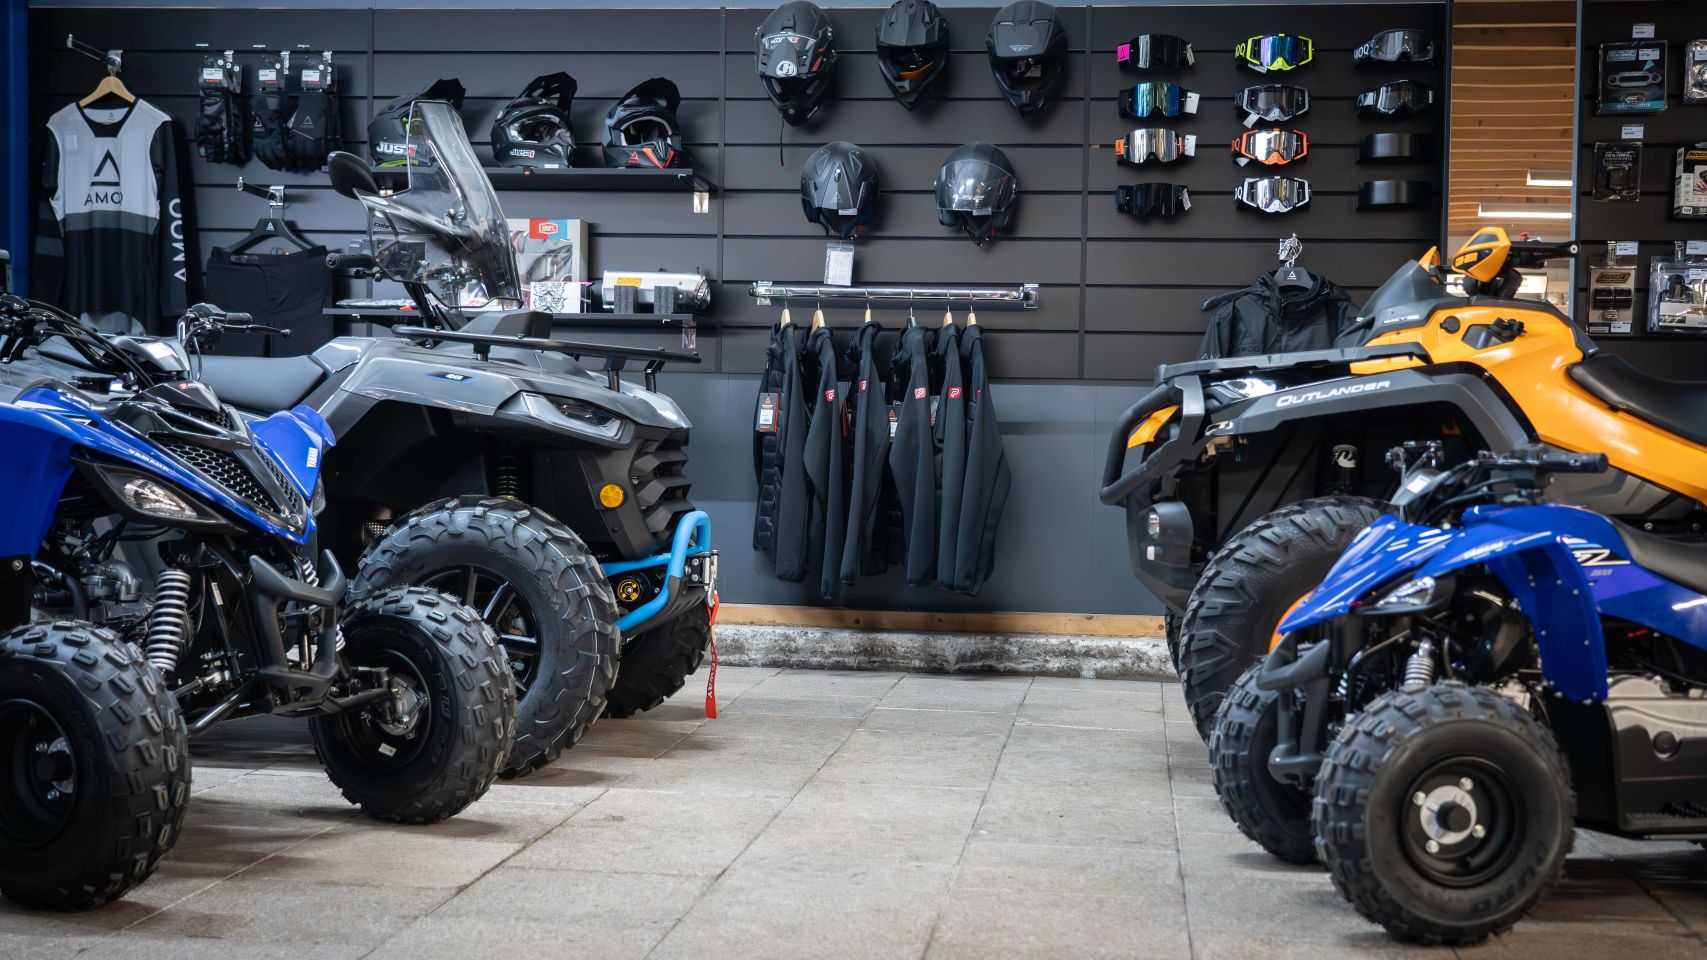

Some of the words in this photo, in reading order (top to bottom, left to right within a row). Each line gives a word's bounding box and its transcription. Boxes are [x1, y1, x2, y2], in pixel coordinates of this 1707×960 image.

[541, 224, 557, 233] 100%
[1599, 271, 1629, 280] MOOSE
[1276, 380, 1391, 408] OUTLANDER
[306, 447, 319, 468] YAMAHA
[707, 652, 716, 699] GWAY
